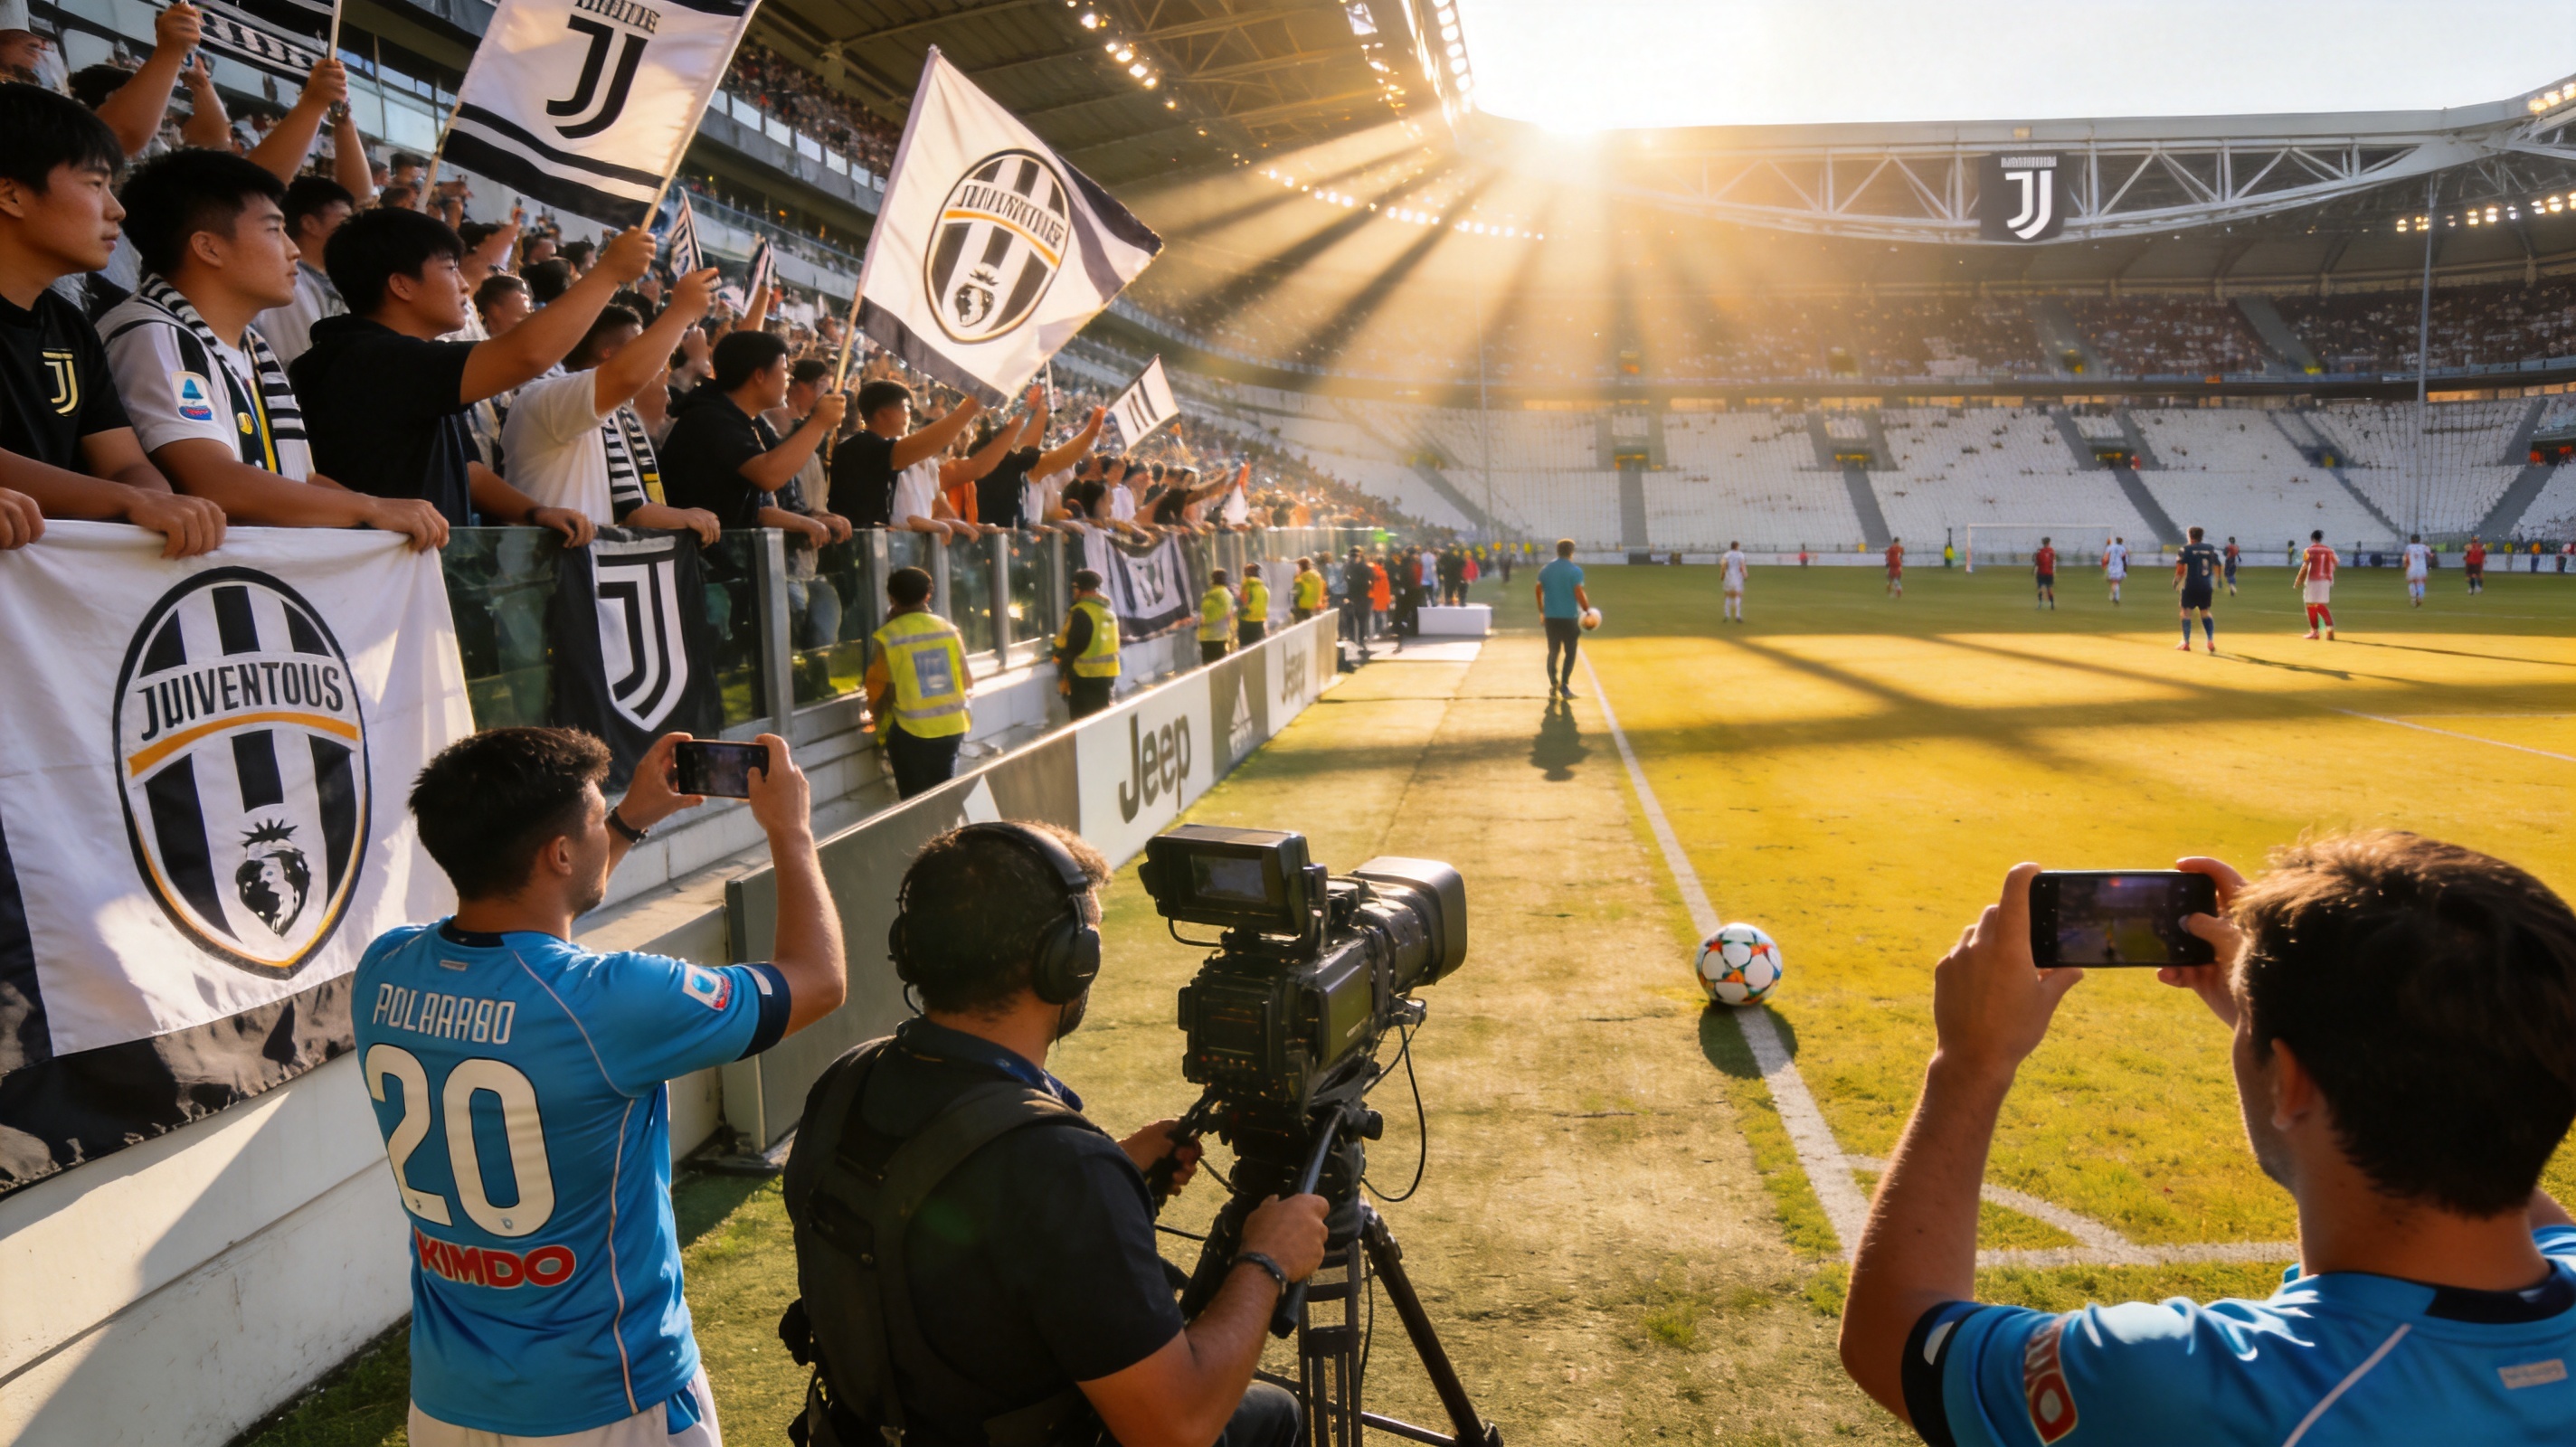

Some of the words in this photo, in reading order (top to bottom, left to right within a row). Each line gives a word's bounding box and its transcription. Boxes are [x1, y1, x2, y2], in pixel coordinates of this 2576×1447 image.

[1119, 713, 1191, 824] Jeep
[365, 1043, 555, 1237] 20
[413, 1225, 577, 1290] KIMDO
